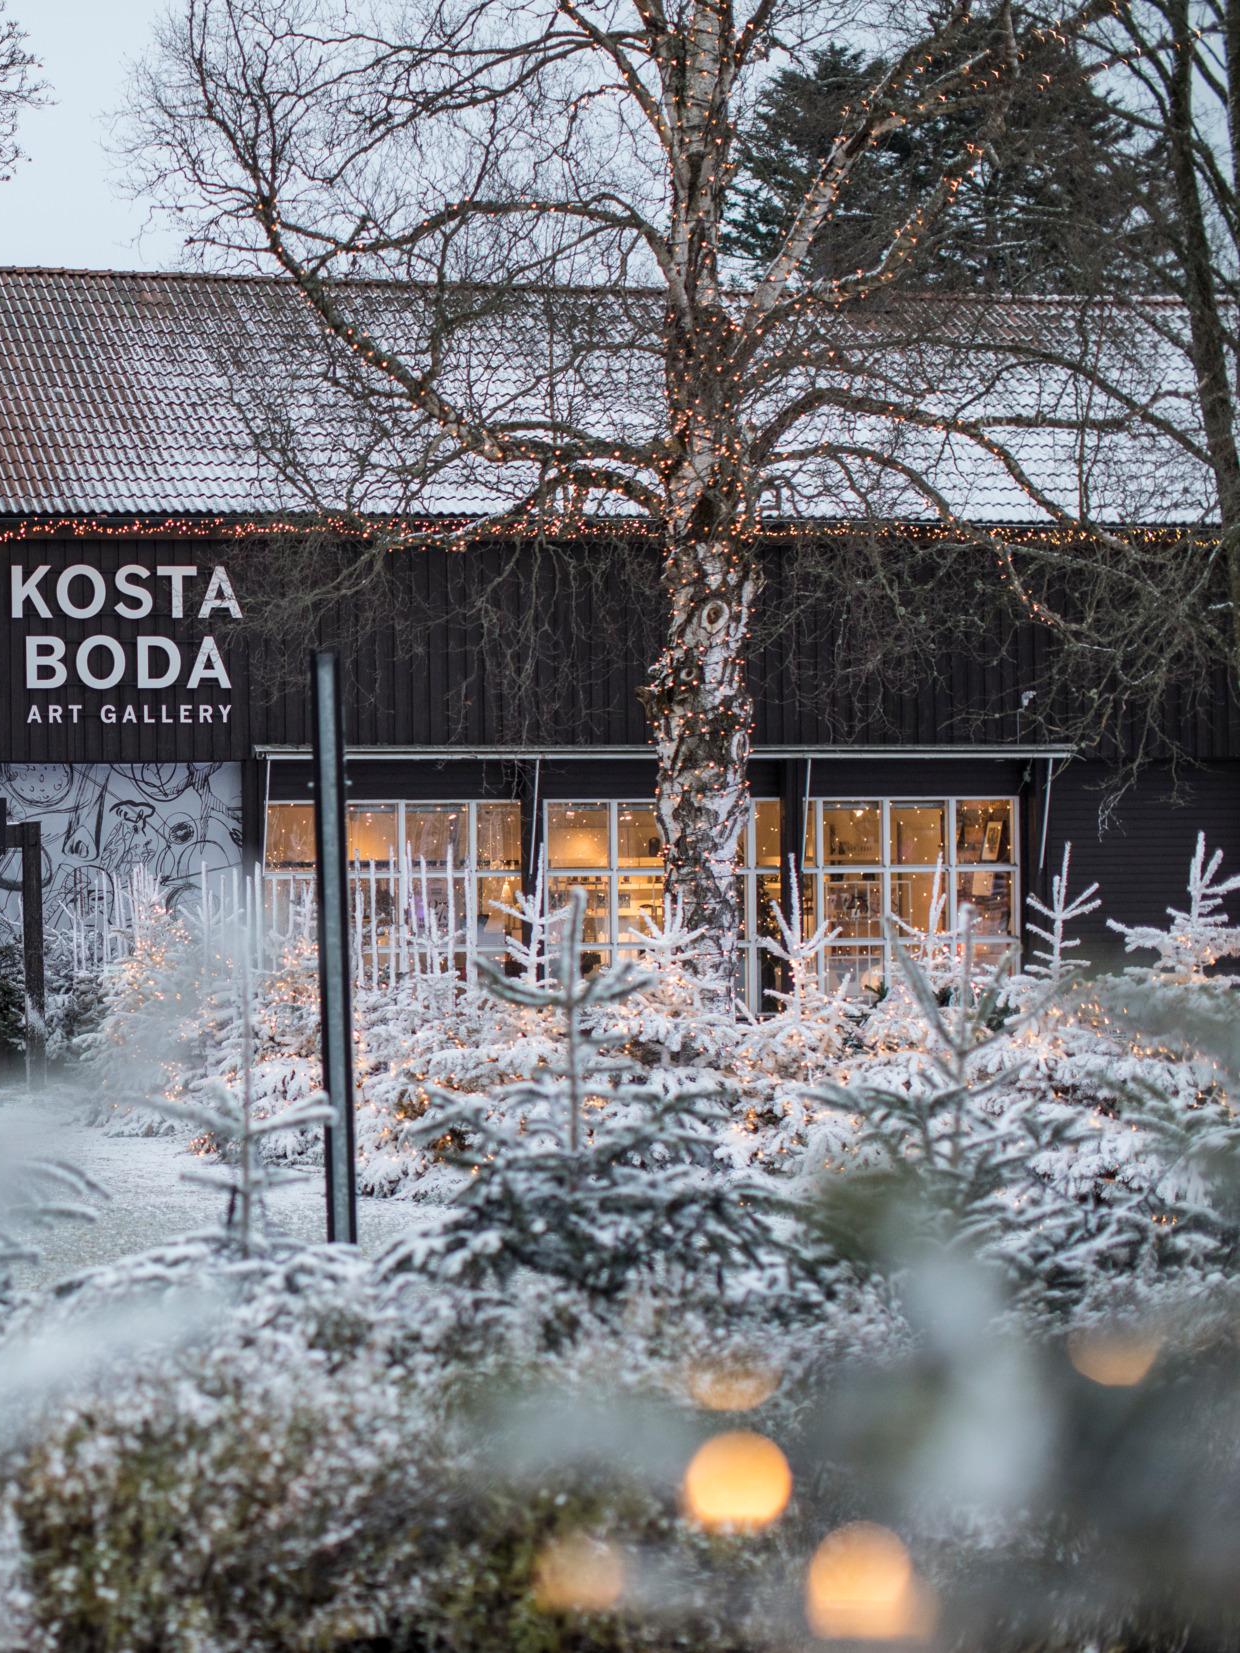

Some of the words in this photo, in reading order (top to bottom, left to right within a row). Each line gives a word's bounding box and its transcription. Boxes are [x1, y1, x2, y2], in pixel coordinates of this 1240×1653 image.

[11, 564, 243, 619] KOSTA
[25, 635, 232, 689] BODA
[26, 704, 82, 723] ART
[100, 704, 232, 723] GALLERY
